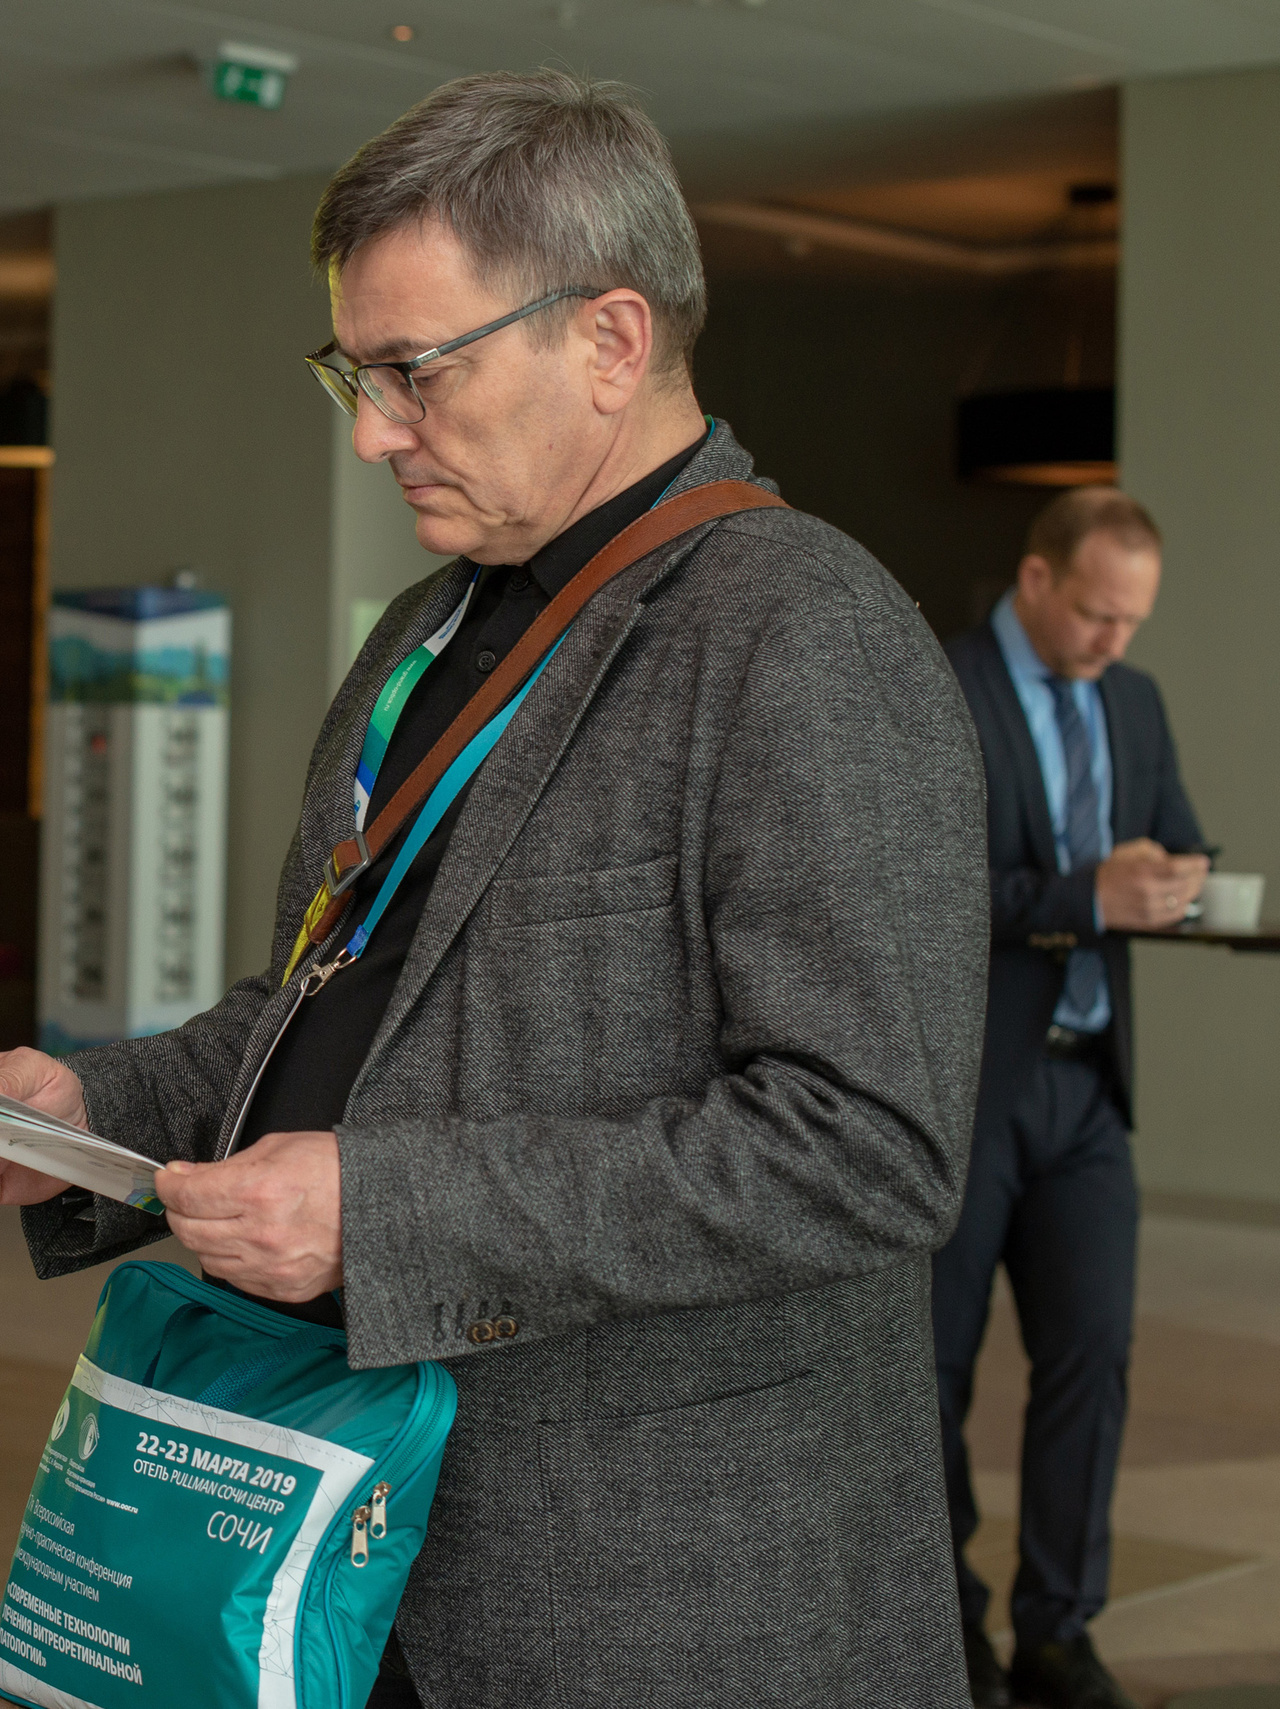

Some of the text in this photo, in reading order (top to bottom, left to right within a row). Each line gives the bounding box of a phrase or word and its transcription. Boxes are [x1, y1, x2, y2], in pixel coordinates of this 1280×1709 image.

[136, 1432, 297, 1496] 22-23 МАРТА 2019
[106, 1498, 139, 1514] www.oor.ru
[133, 1458, 285, 1516] ОТЕЛЬ PULLMAN СОЧИ ЦЕНТР
[33, 1498, 75, 1536] Всероссийская
[207, 1510, 274, 1555] СОЧИ
[63, 1574, 100, 1602] участием
[75, 1551, 133, 1589] конференция
[7, 1581, 130, 1656] «СОВРЕМЕННЫЕ ТЕХНОЛОГИИ
[2, 1603, 143, 1686] ЛЕЧЕНИЯ ВИТРЕОРЕТИНАЛЬНОЙ
